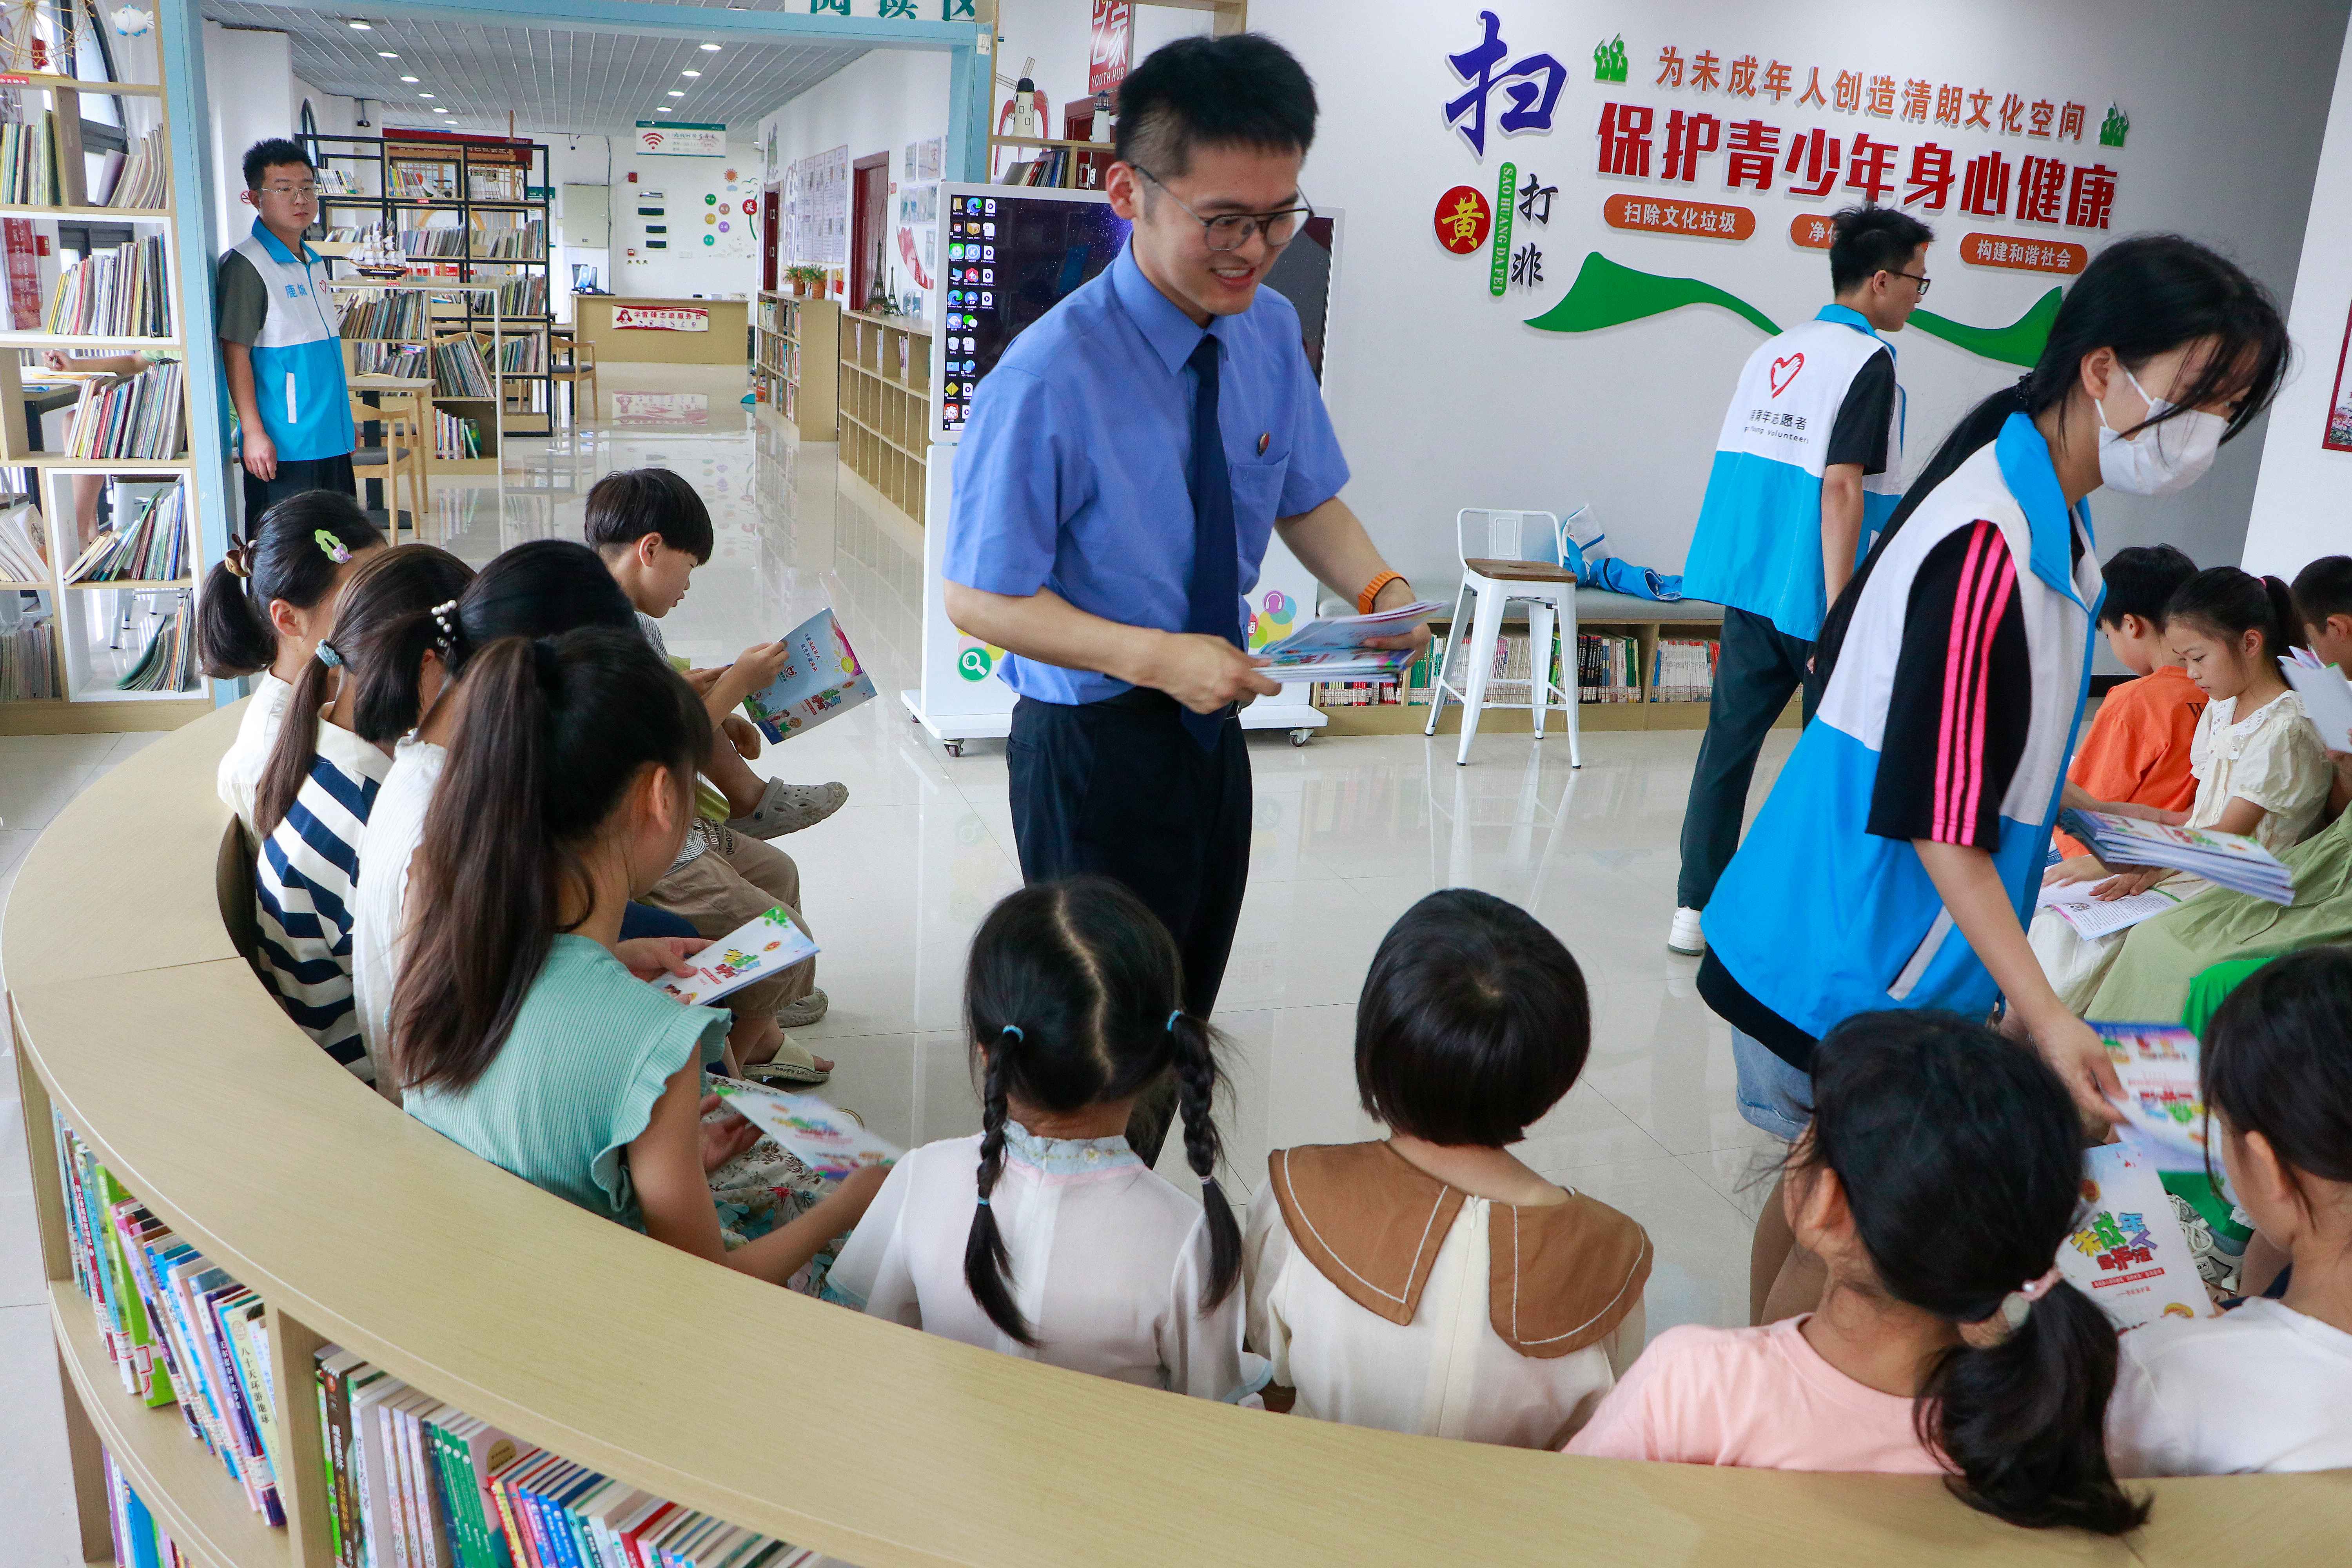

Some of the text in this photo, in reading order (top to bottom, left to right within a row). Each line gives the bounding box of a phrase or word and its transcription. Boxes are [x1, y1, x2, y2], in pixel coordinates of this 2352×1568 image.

[1091, 67, 1125, 87] YOUTH HUB
[1445, 11, 1567, 157] 扫
[1656, 45, 2086, 140] 为未成年人创造清朗文化空间
[1597, 102, 2118, 229] 保护青少年身心健康
[1441, 192, 1485, 249] 黄
[1493, 167, 1514, 291] SAO HUANG DA FEI
[1624, 201, 1736, 233] 扫除文化垃圾
[1976, 238, 2072, 269] 构建和谐社会
[285, 282, 307, 298] 鹿城
[241, 1346, 270, 1424] 八十天环游地球
